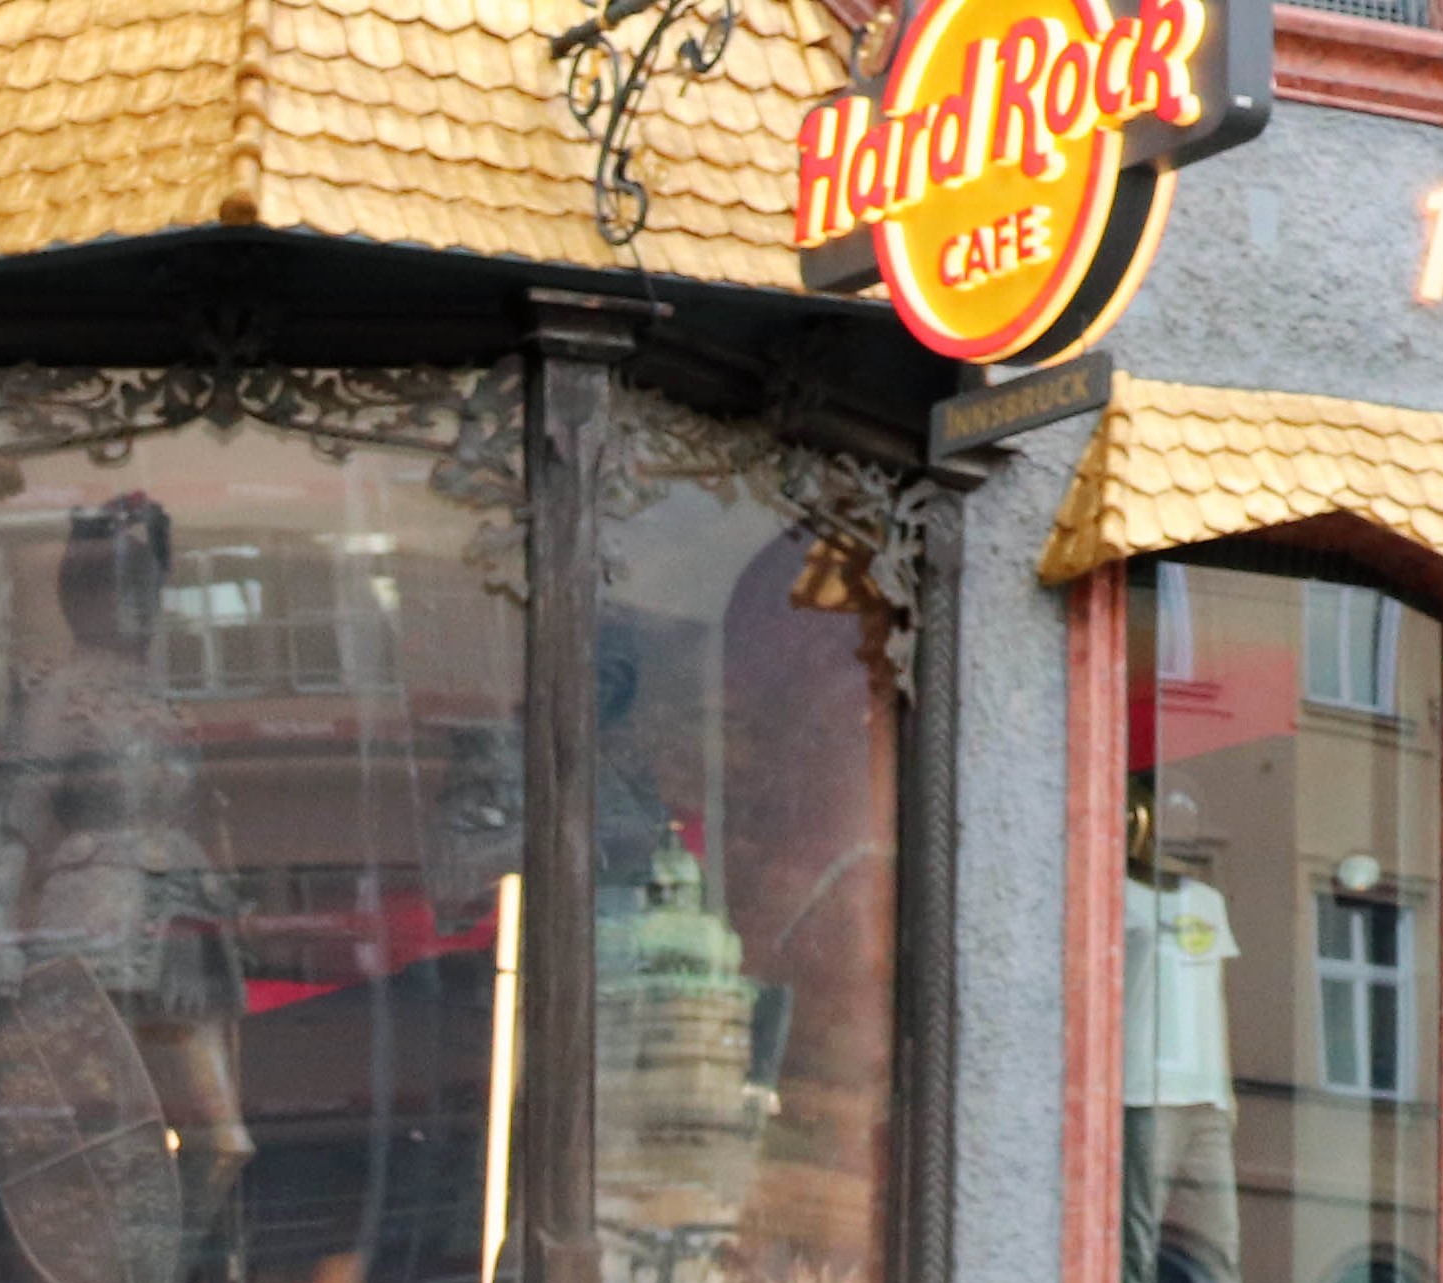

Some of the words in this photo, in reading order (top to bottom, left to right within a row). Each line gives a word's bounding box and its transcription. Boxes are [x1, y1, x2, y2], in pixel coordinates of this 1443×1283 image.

[795, 40, 999, 248] Hard
[991, 0, 1205, 181] Rock
[939, 206, 1051, 291] CAFE
[945, 370, 1089, 440] INNSBRUCK
